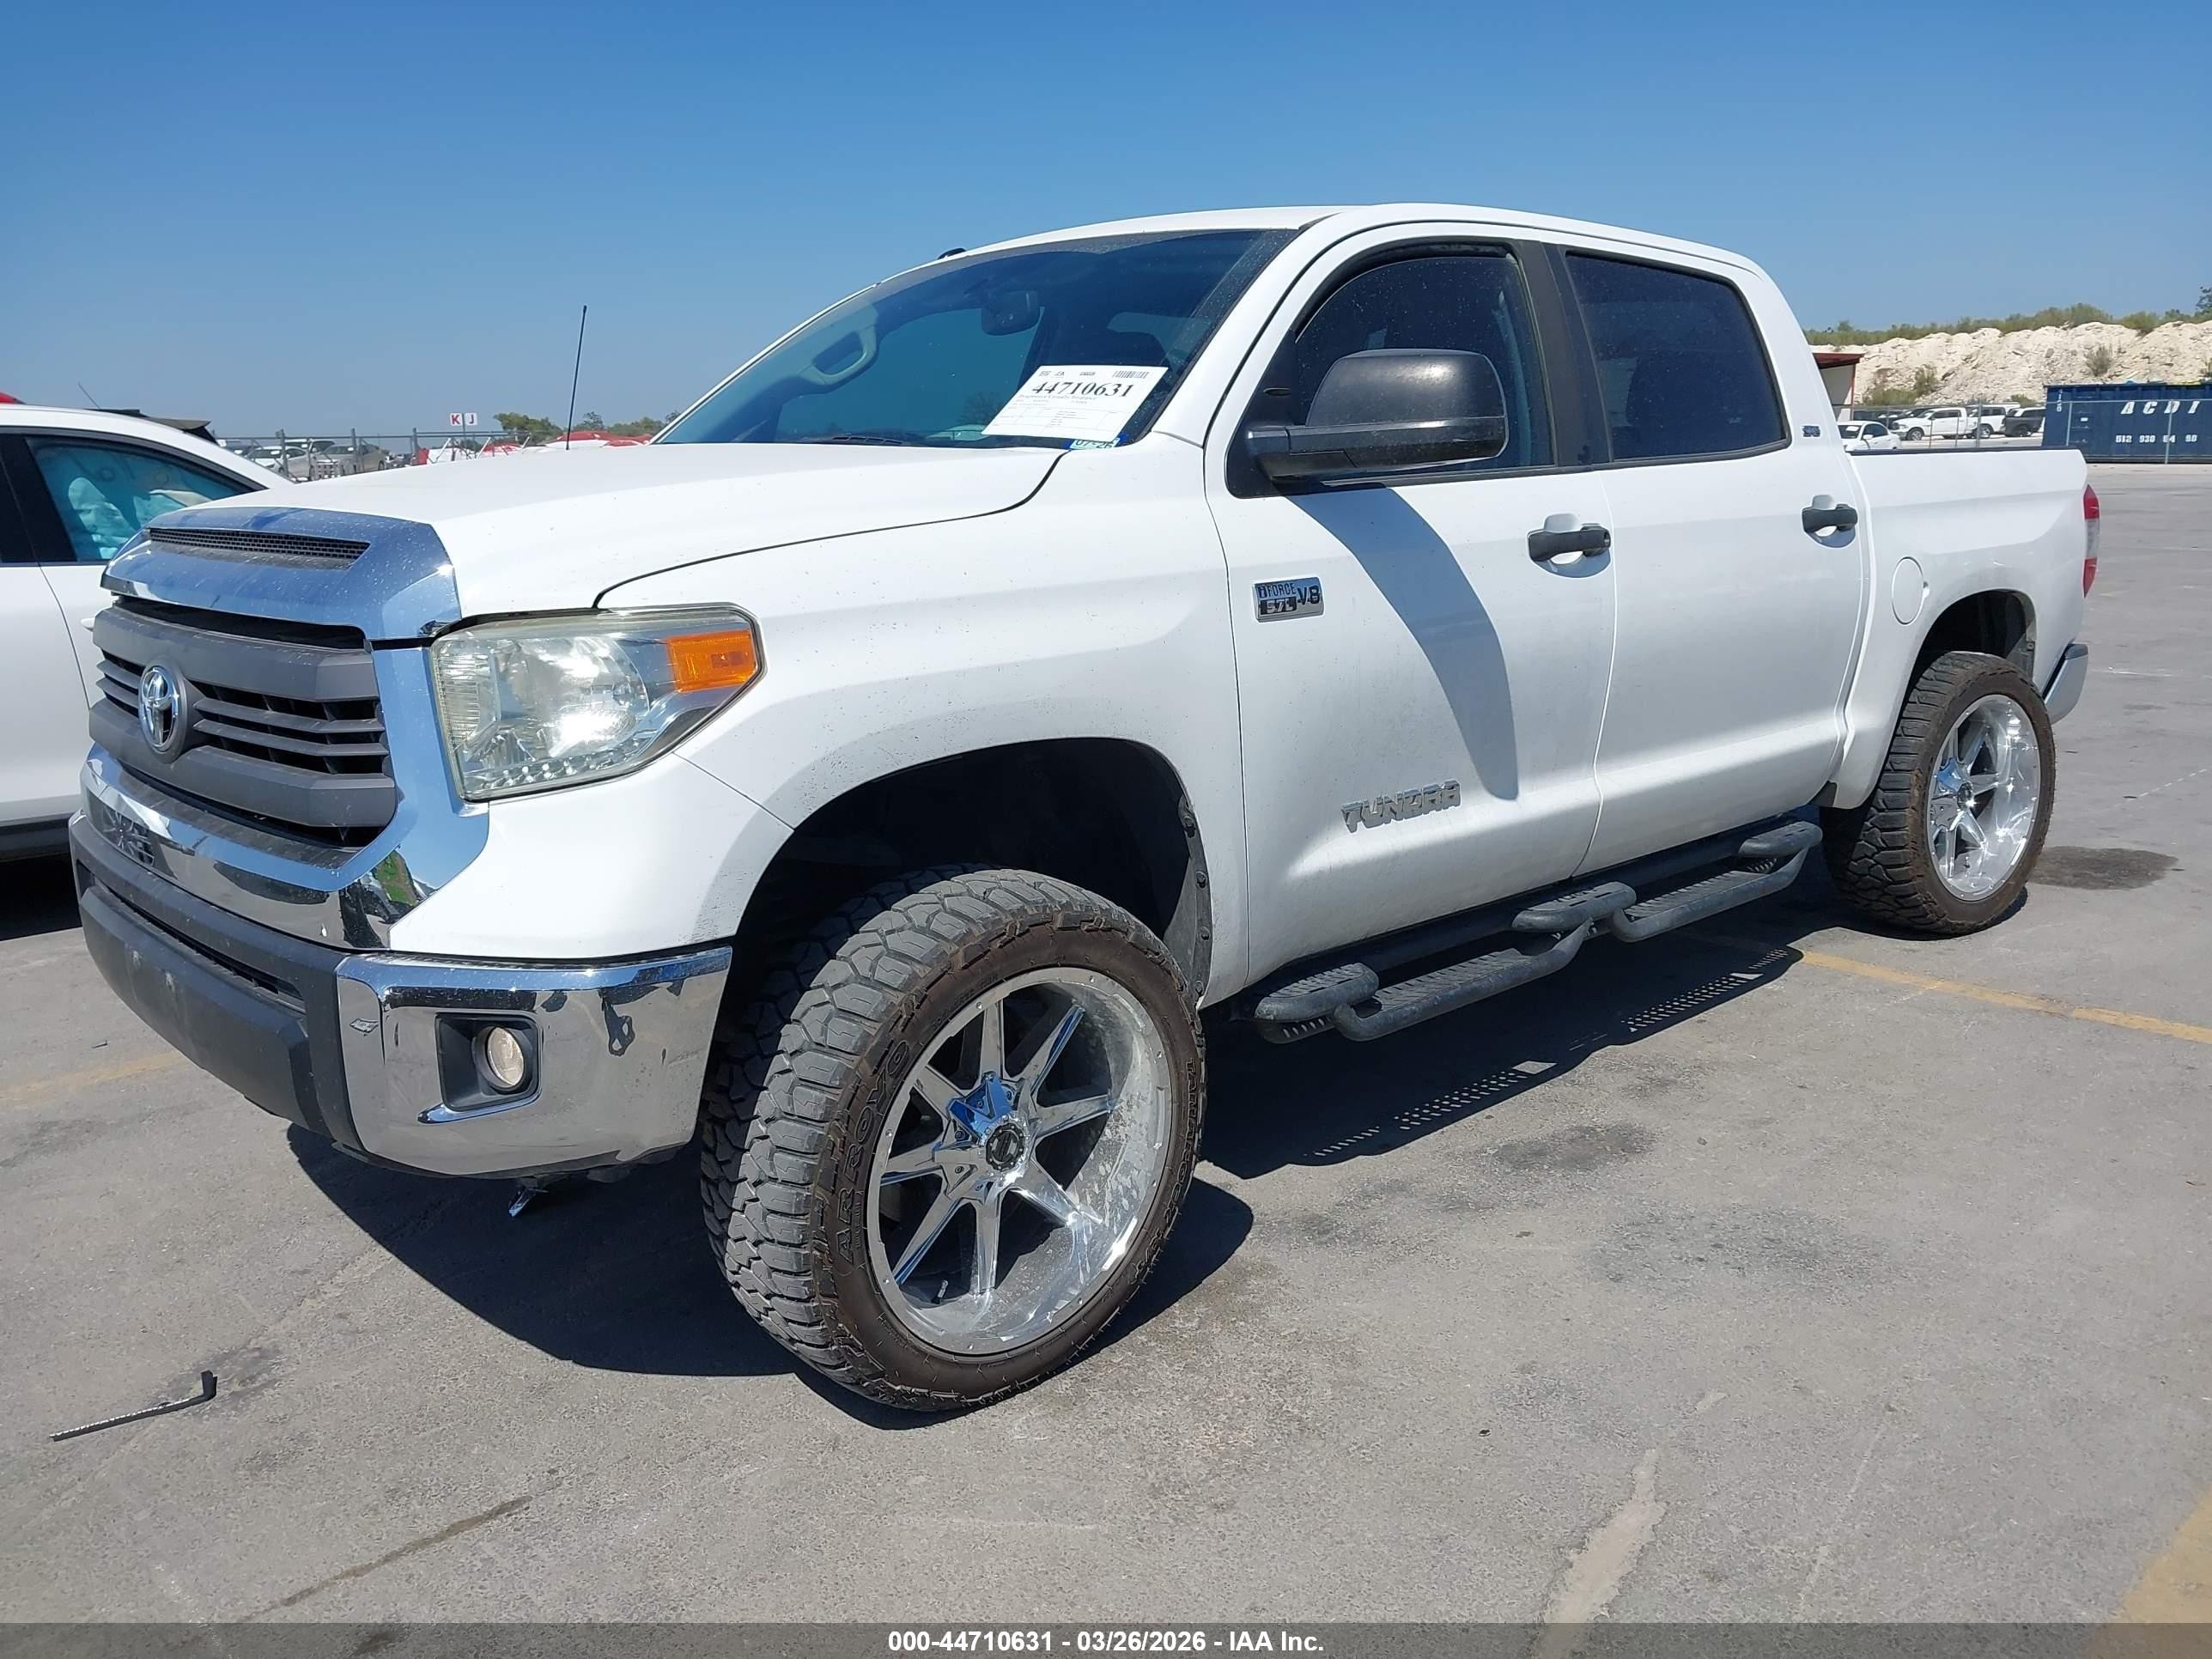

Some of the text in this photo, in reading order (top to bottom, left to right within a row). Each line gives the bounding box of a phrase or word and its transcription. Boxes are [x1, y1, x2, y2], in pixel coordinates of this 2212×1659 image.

[1032, 381, 1134, 398] 44710631
[451, 414, 461, 425] K
[1297, 585, 1321, 605] V8
[1340, 779, 1462, 833] TUNDRA
[836, 1039, 910, 1264] ARROYO
